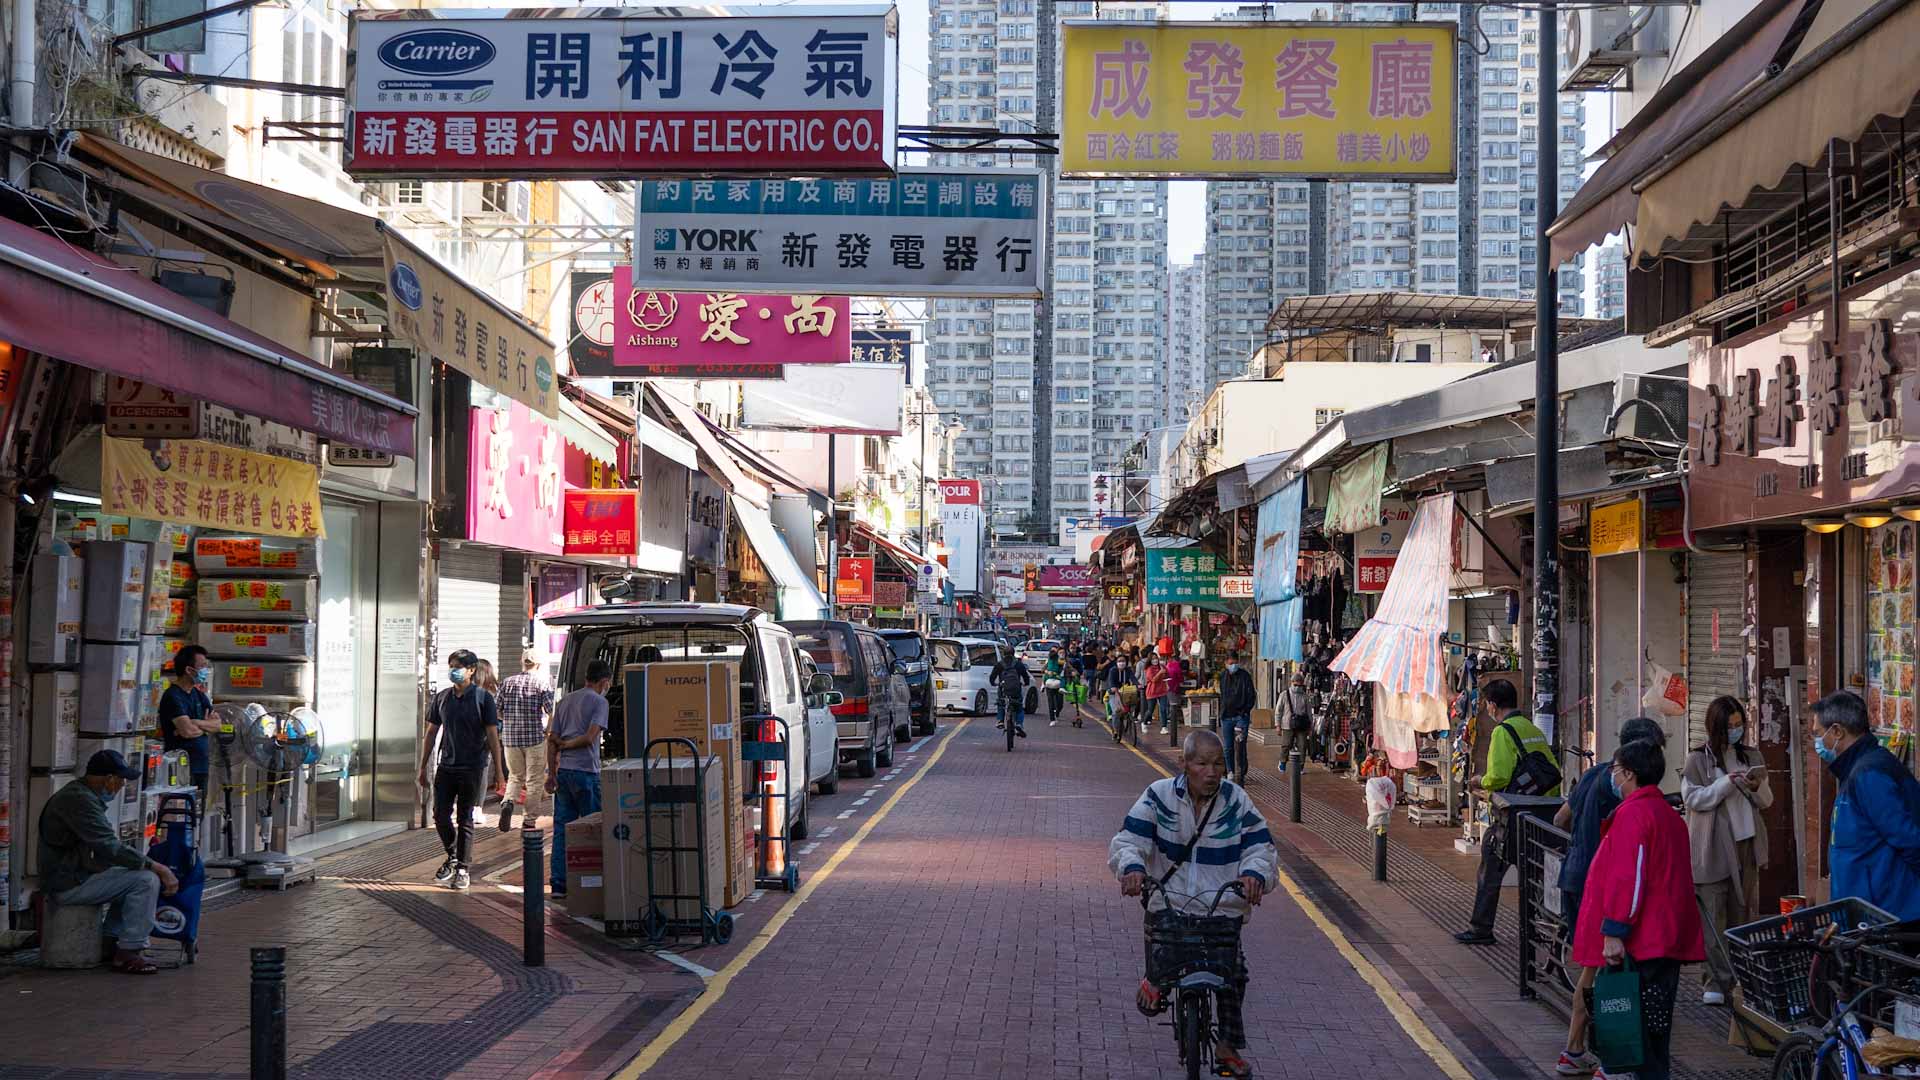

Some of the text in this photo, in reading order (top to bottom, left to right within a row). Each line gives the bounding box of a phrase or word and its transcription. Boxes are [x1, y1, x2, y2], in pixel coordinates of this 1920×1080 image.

[395, 40, 480, 60] Carrier
[525, 29, 872, 101] 開利冷氣
[1089, 39, 1434, 119] 成發餐廳
[363, 117, 558, 156] 新發電器行
[572, 118, 880, 154] SAN FAT ELECTRIC CO.
[1087, 132, 1432, 163] 西冷紅茶 粥粉麵飯 精美小炒
[657, 179, 1034, 208] 約克家用及商用空調設備
[679, 229, 758, 252] YORK
[782, 232, 1033, 273] 新發電器行
[653, 256, 760, 272] 特約經銷商
[627, 334, 678, 347] Aishang
[312, 388, 391, 449] 美源化妝品
